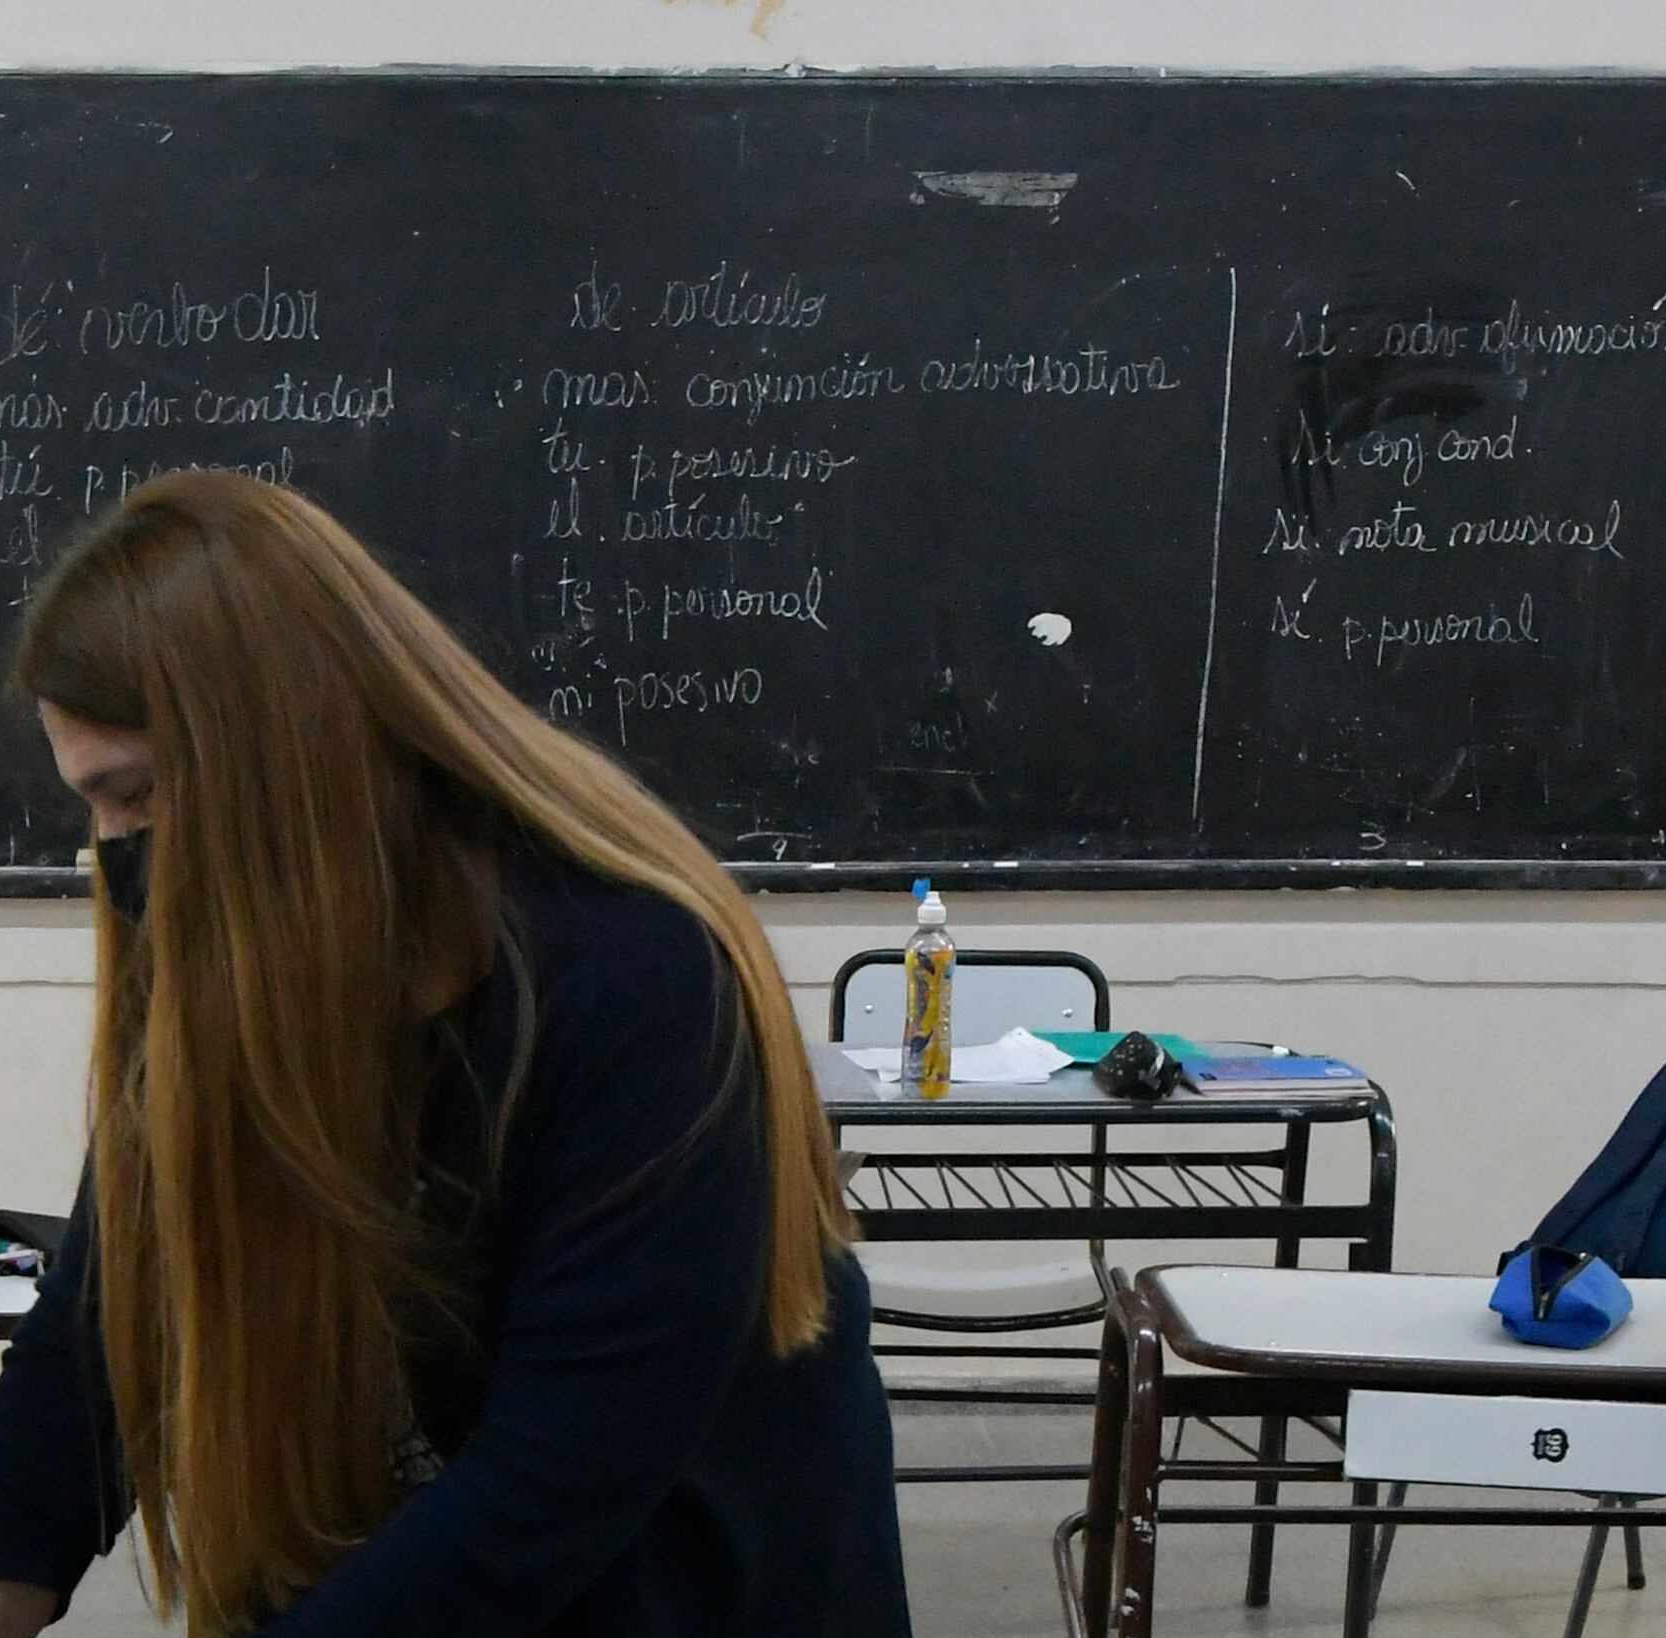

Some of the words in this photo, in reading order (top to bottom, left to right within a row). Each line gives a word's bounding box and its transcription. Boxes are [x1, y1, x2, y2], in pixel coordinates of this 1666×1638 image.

[80, 282, 227, 355] verbo
[235, 266, 321, 342] dar
[1339, 501, 1438, 556] nota
[1449, 500, 1626, 560] musical
